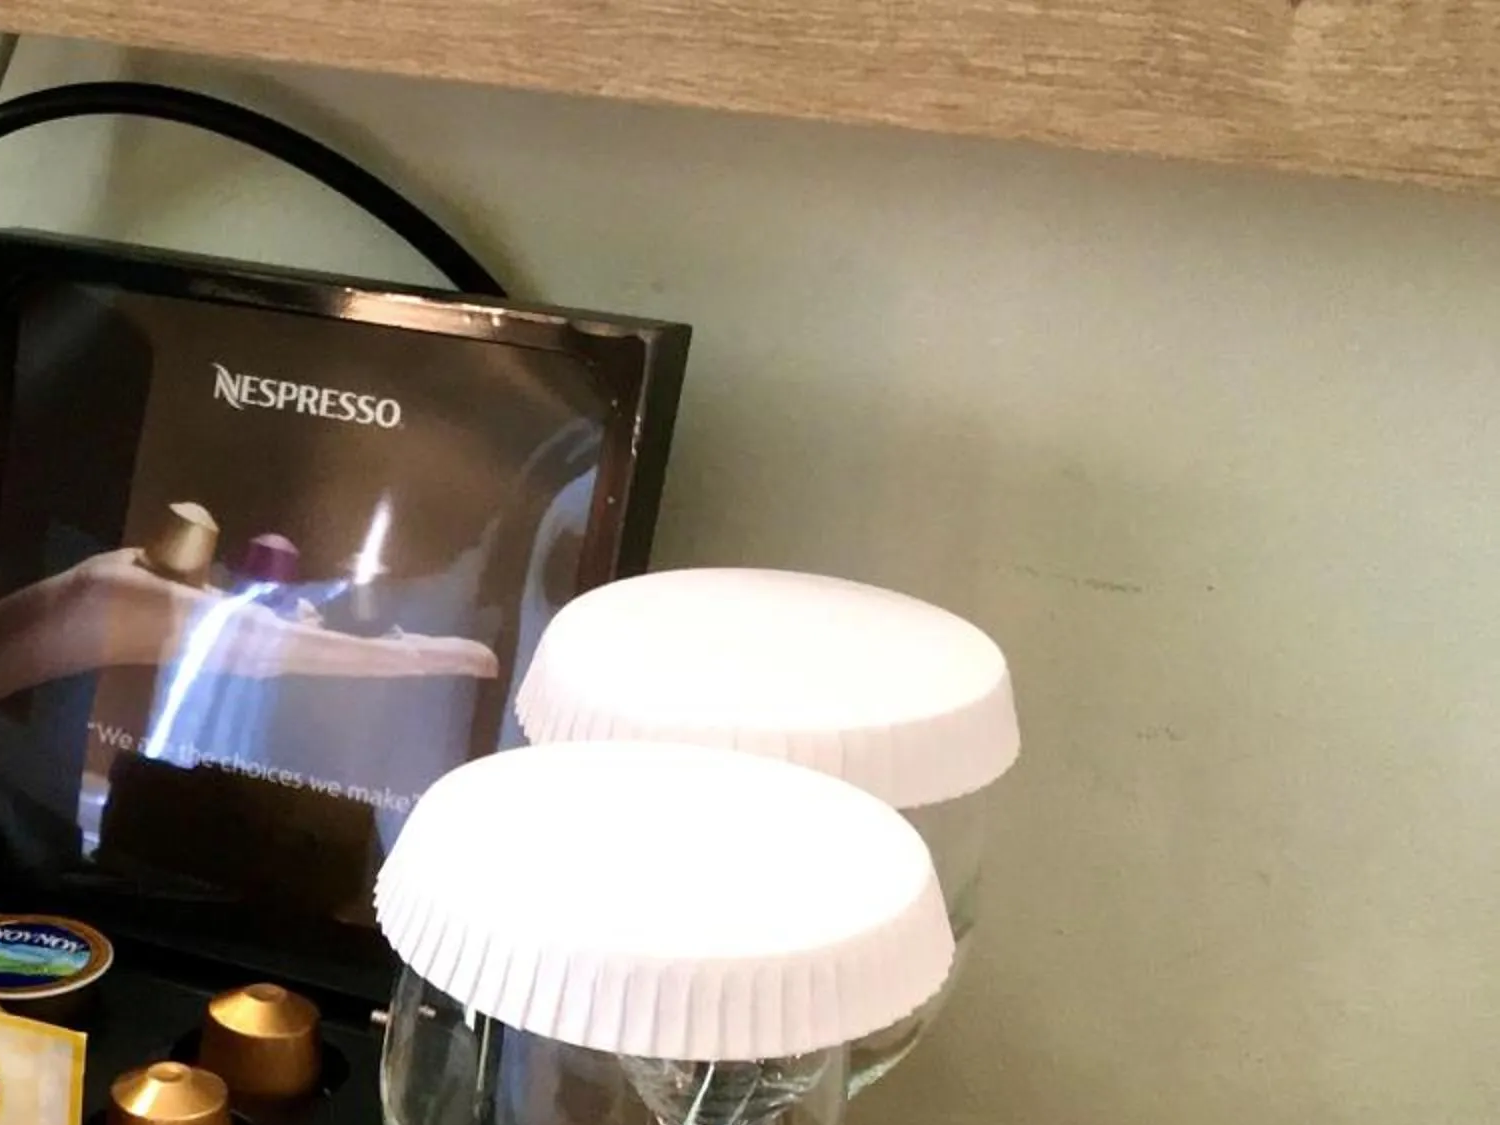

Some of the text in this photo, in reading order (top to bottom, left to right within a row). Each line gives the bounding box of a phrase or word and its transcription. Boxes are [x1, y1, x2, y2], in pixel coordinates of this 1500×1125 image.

[212, 362, 401, 428] NESPRESSO
[219, 751, 303, 789] choices
[309, 776, 342, 798] we
